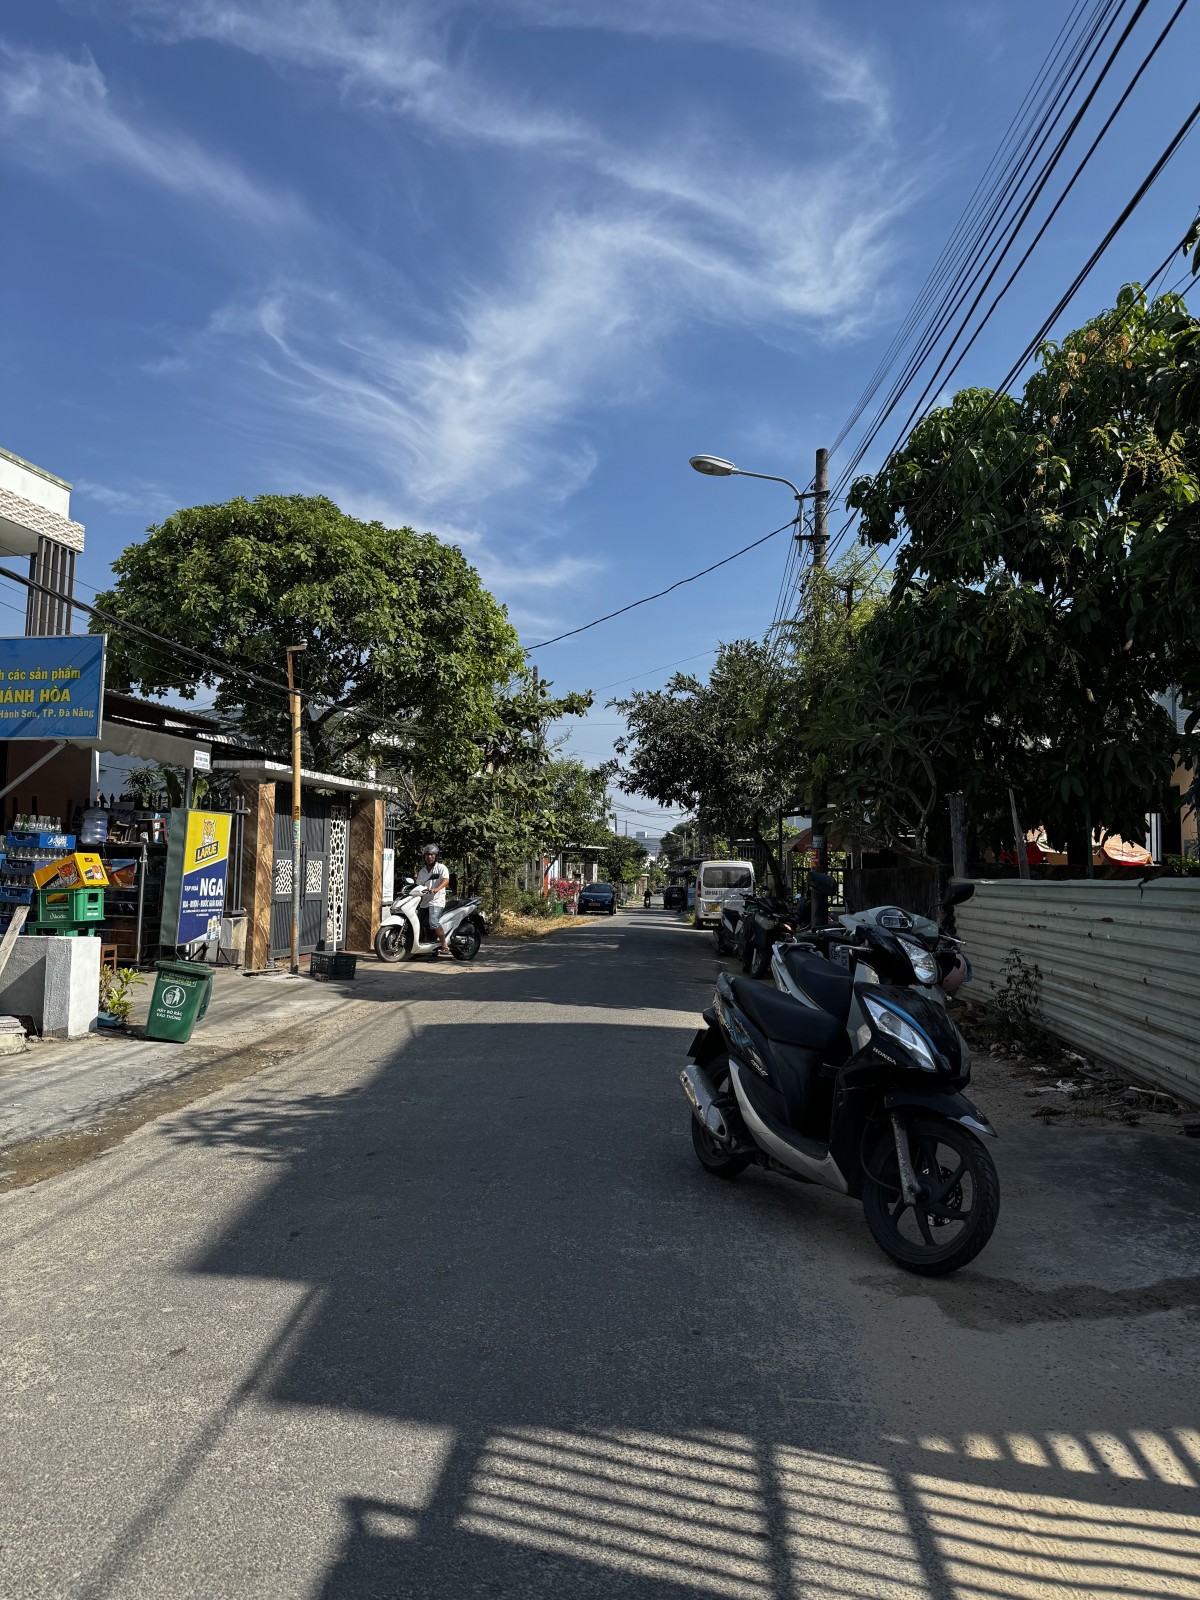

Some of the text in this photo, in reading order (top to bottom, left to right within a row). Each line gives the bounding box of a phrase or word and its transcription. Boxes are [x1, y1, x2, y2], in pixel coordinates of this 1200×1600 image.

[8, 668, 26, 681] các
[29, 666, 48, 681] sản
[51, 664, 81, 682] phẩm
[40, 685, 71, 703] HÒA
[21, 709, 40, 720] Sơn,
[42, 708, 57, 718] TP.
[59, 708, 70, 718] Đà
[72, 706, 95, 719] Nẵng
[197, 843, 218, 861] LARUE
[200, 878, 224, 897] NGA
[872, 1047, 898, 1066] HONDA
